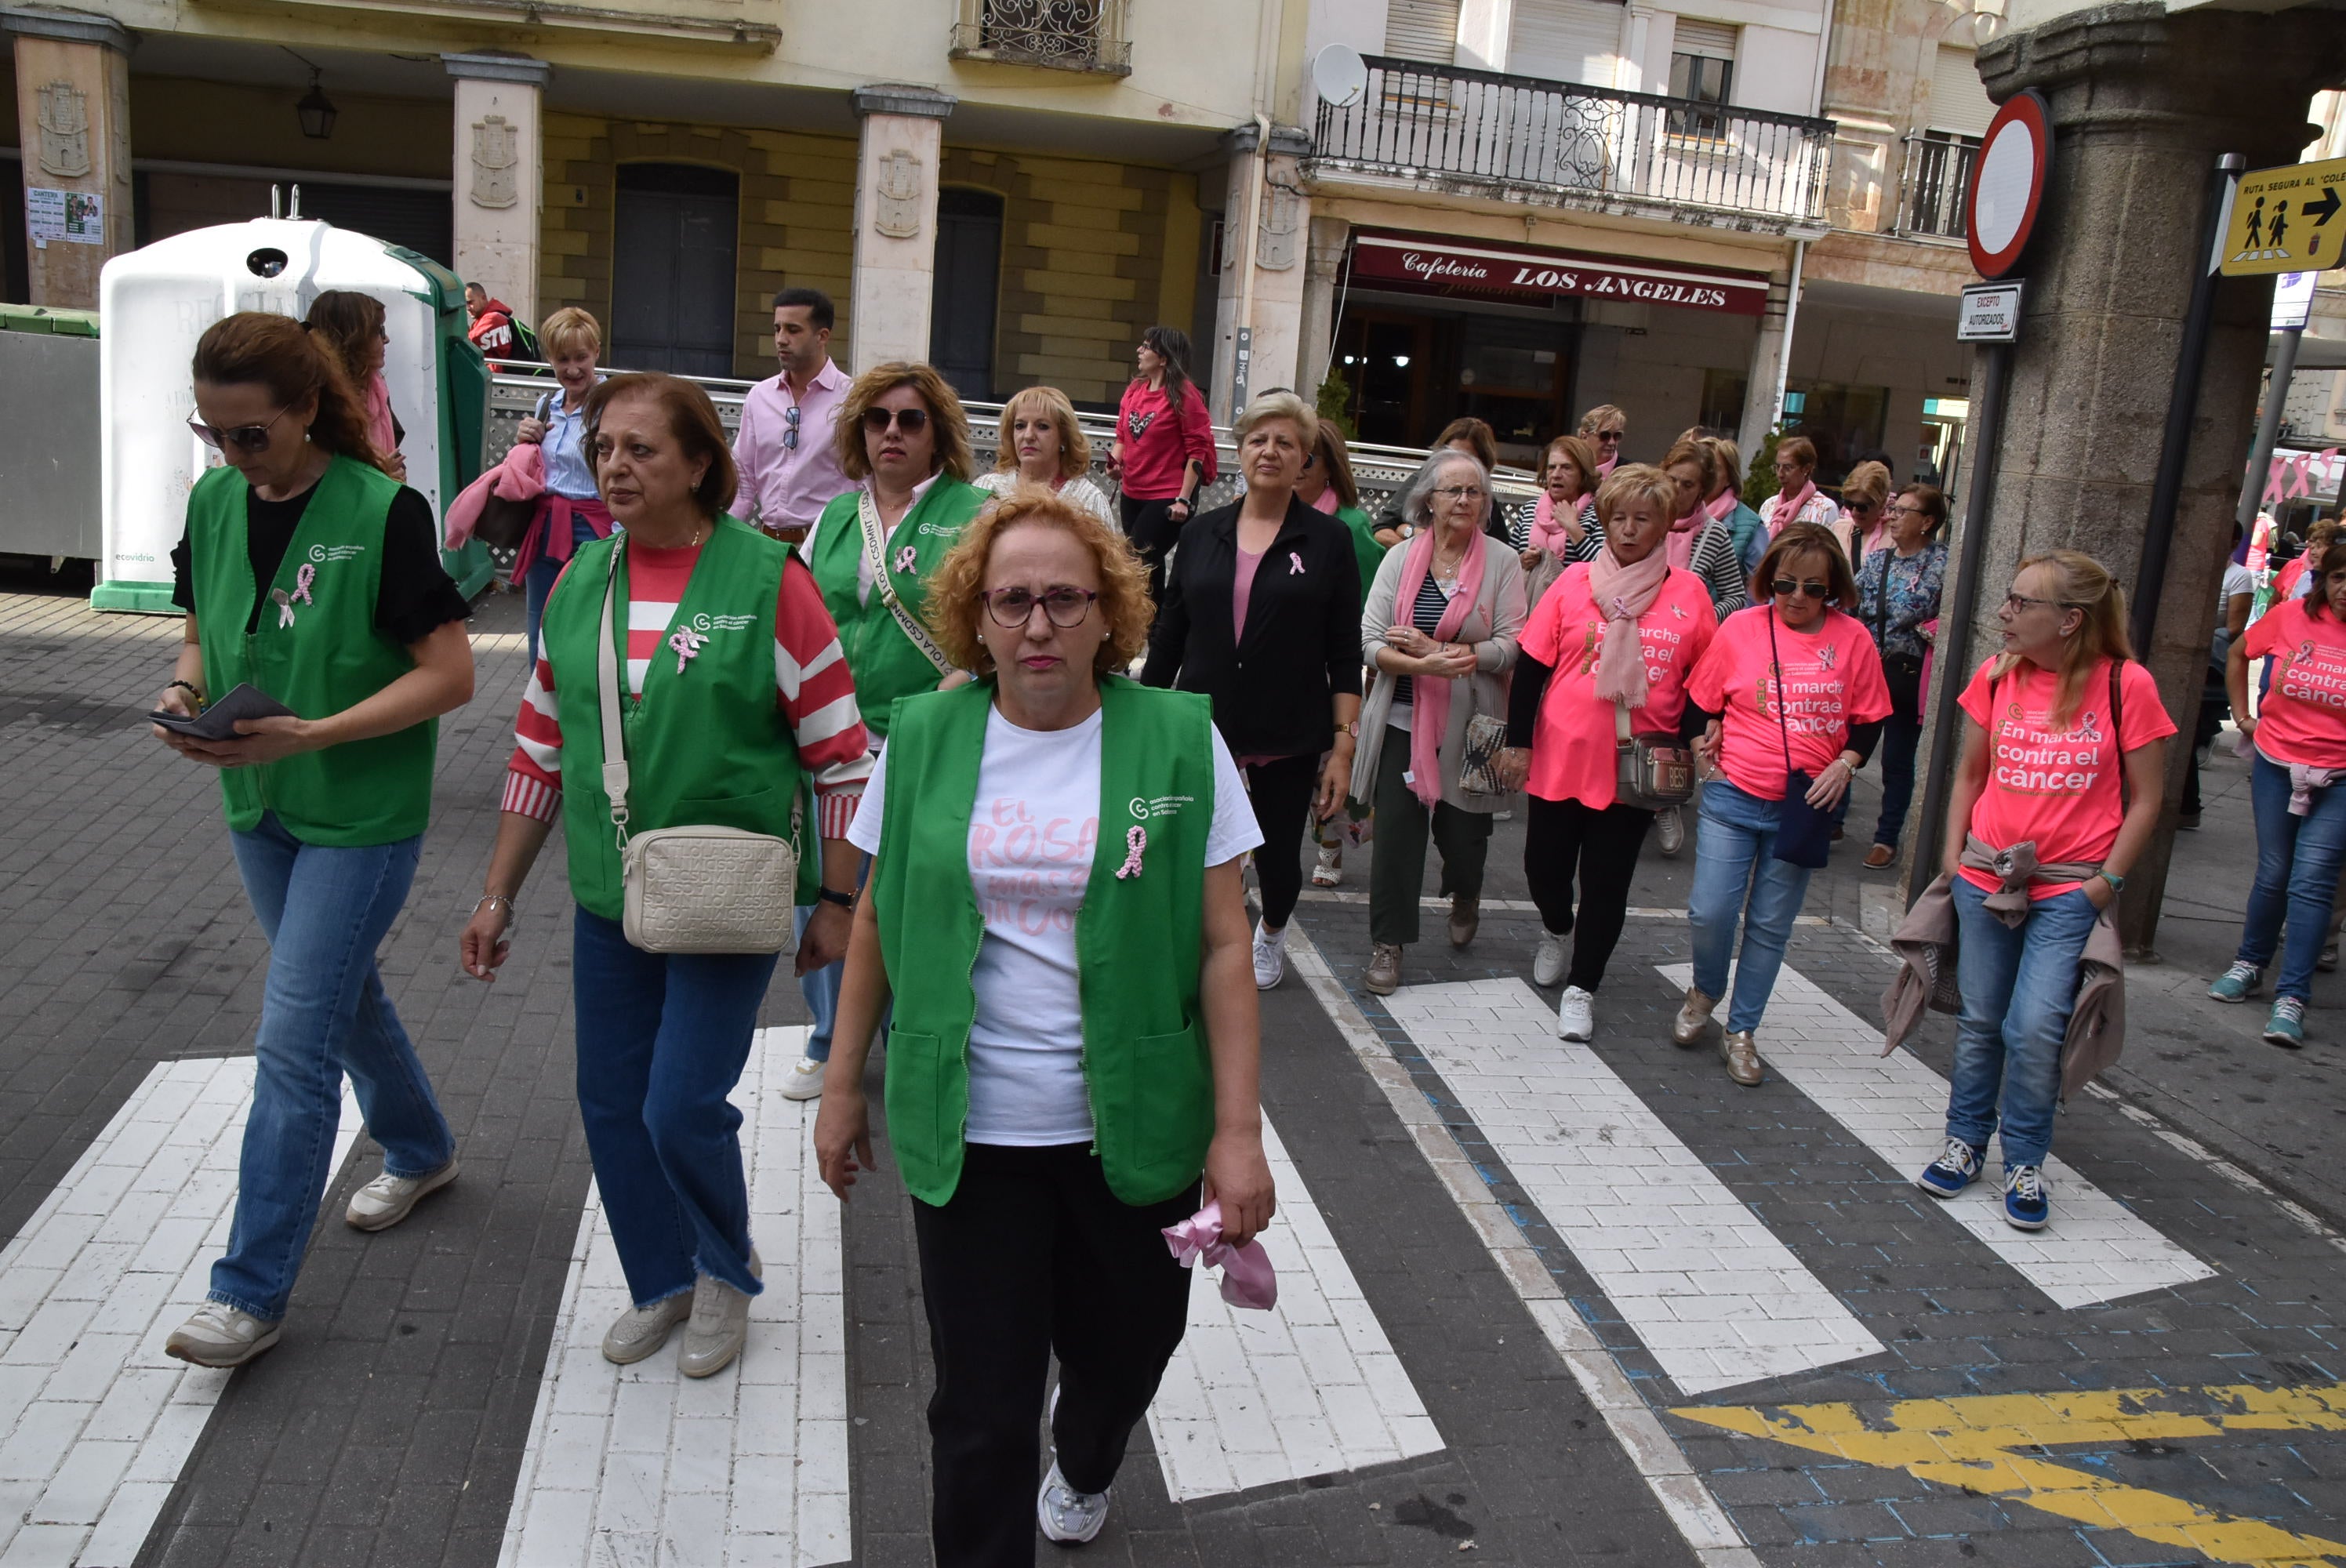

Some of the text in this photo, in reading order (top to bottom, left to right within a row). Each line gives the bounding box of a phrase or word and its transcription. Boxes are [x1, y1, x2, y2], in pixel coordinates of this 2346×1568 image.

[2243, 183, 2264, 194] RUTA
[2267, 179, 2301, 192] SEGURA
[2304, 176, 2315, 187] AL
[1402, 252, 1726, 307] Cafetería LOS ANGELES
[1977, 295, 2000, 308] EXCEPTO
[1969, 313, 2004, 325] AUTORIZADOS
[115, 552, 155, 562] ecovidrio
[864, 521, 888, 589] LOLA CSDMNT
[1658, 648, 1674, 662] el
[2002, 720, 2025, 740] En
[1997, 744, 2099, 765] contra el
[1669, 767, 1687, 788] BEST
[1996, 764, 2098, 789] cáncer
[971, 816, 1099, 869] ROSA
